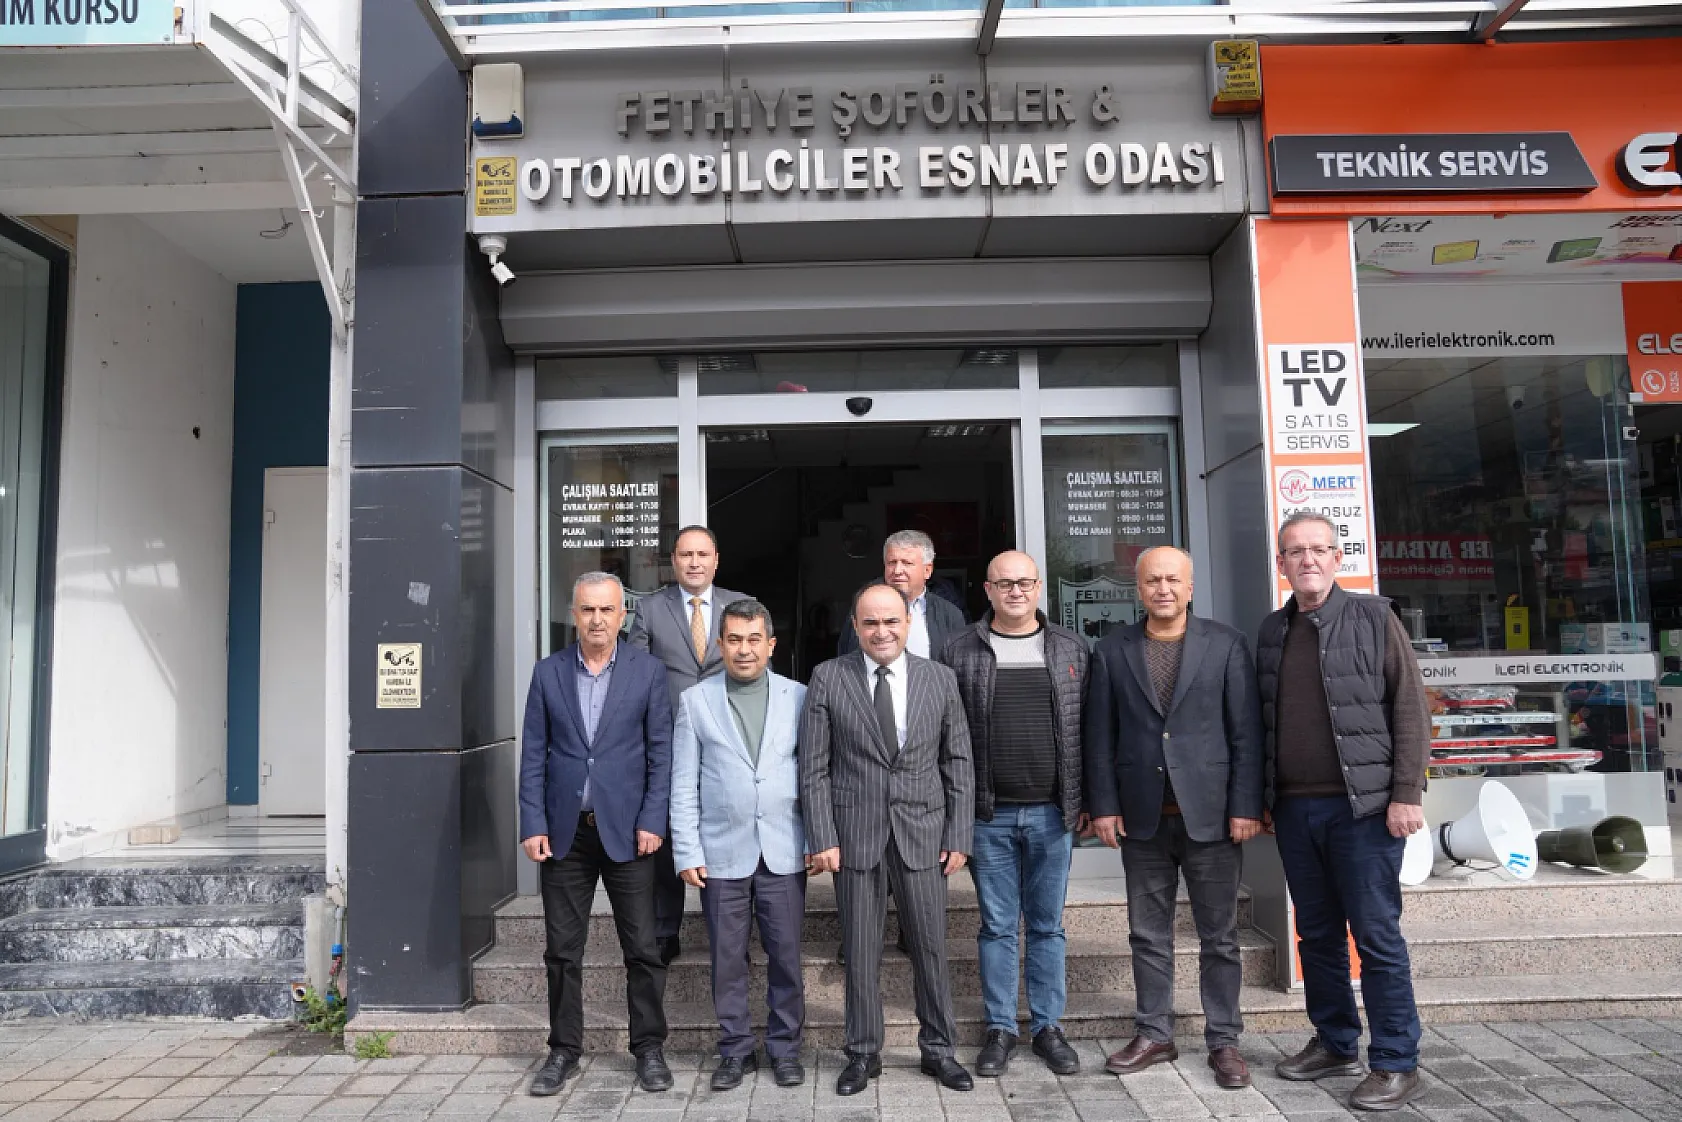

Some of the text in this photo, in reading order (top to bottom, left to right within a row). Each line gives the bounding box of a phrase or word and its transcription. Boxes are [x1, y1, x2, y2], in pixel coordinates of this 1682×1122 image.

[616, 73, 1119, 138] FETHİYE ŞOFÖRLER &
[521, 138, 1224, 201] OTOMOBİLCİLER ESNAF ODASI
[1316, 142, 1549, 178] TEKNİK SERVİS
[1361, 330, 1555, 349] ww.ilerielektronik.com
[1281, 350, 1346, 374] LED
[1283, 377, 1347, 407] TV
[1066, 468, 1163, 488] ÇALIŞMA SAATLERİ
[1313, 475, 1356, 489] MERT
[562, 481, 659, 501] ÇALIŞMA SAATLERİ
[1076, 587, 1135, 599] FETHİYE
[1495, 660, 1624, 677] İLERİ ELEKTRONİK
